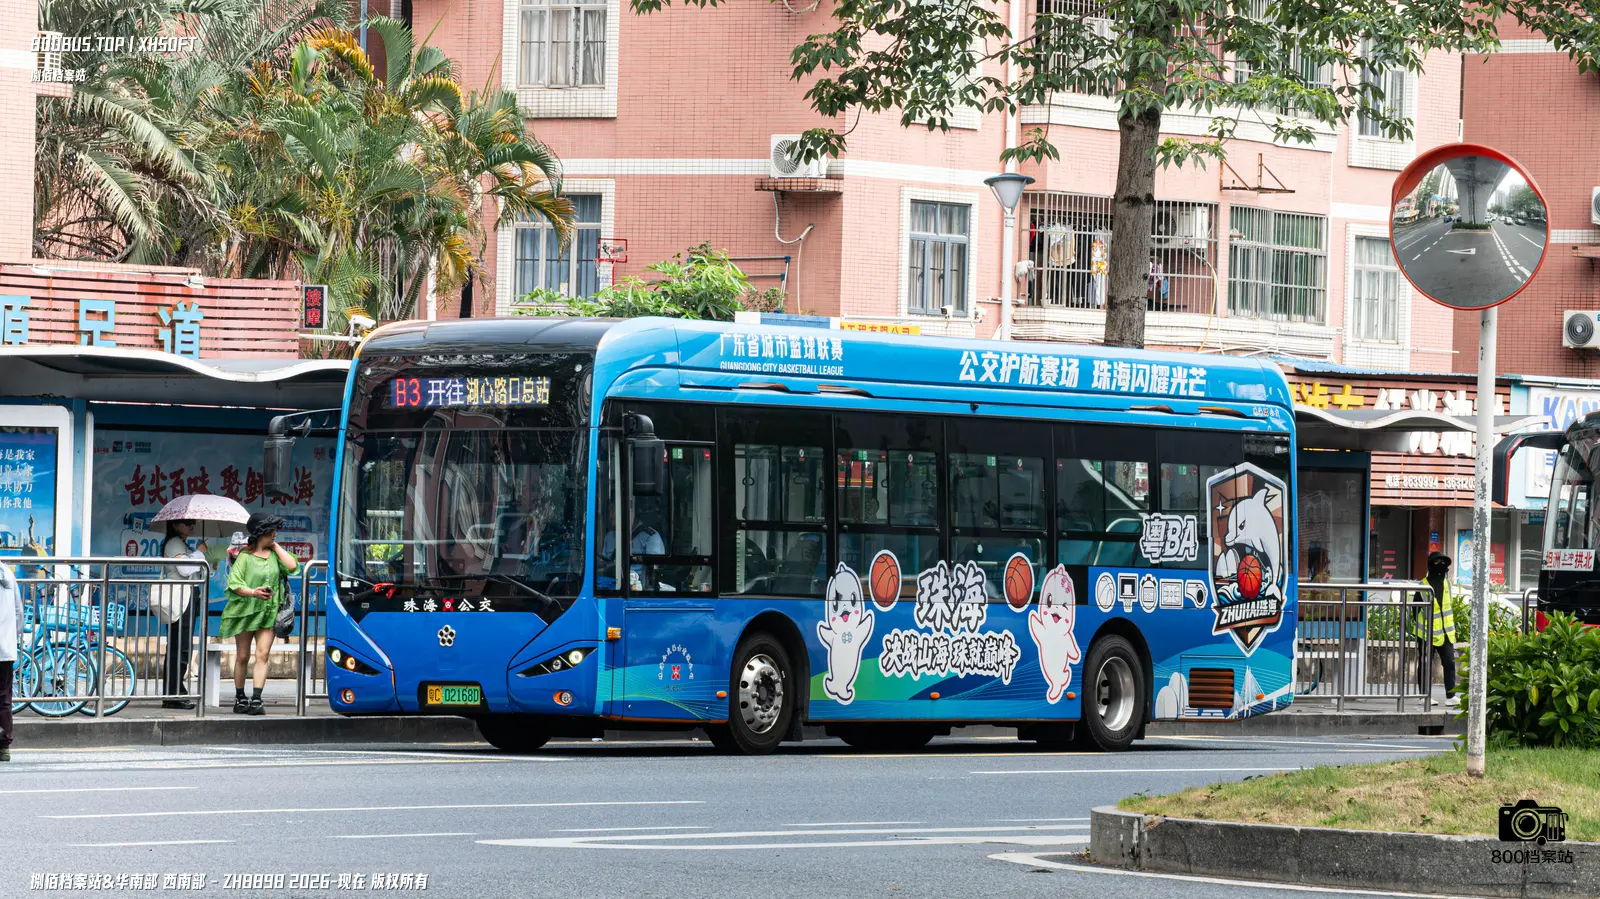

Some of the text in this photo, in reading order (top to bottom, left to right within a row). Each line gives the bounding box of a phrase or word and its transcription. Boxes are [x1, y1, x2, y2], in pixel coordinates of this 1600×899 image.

[305, 289, 321, 326] 按摩
[719, 333, 844, 360] 广东省城市篮球联赛
[720, 361, 844, 376] GUANGDONG CITY BASKETBALL LEAGUE
[959, 350, 1207, 397] 公交护航赛场 珠海闪耀光芒
[396, 377, 550, 406] B3 开往湖心路口总站
[0, 497, 32, 509] 你我他
[1143, 516, 1198, 561] 粤BA
[1574, 551, 1593, 569] 拱北
[403, 597, 496, 612] 珠海 公交
[917, 561, 988, 633] 珠海
[882, 633, 1018, 681] 决战山海 珠就巅峰
[428, 688, 480, 702] 粤C02168D
